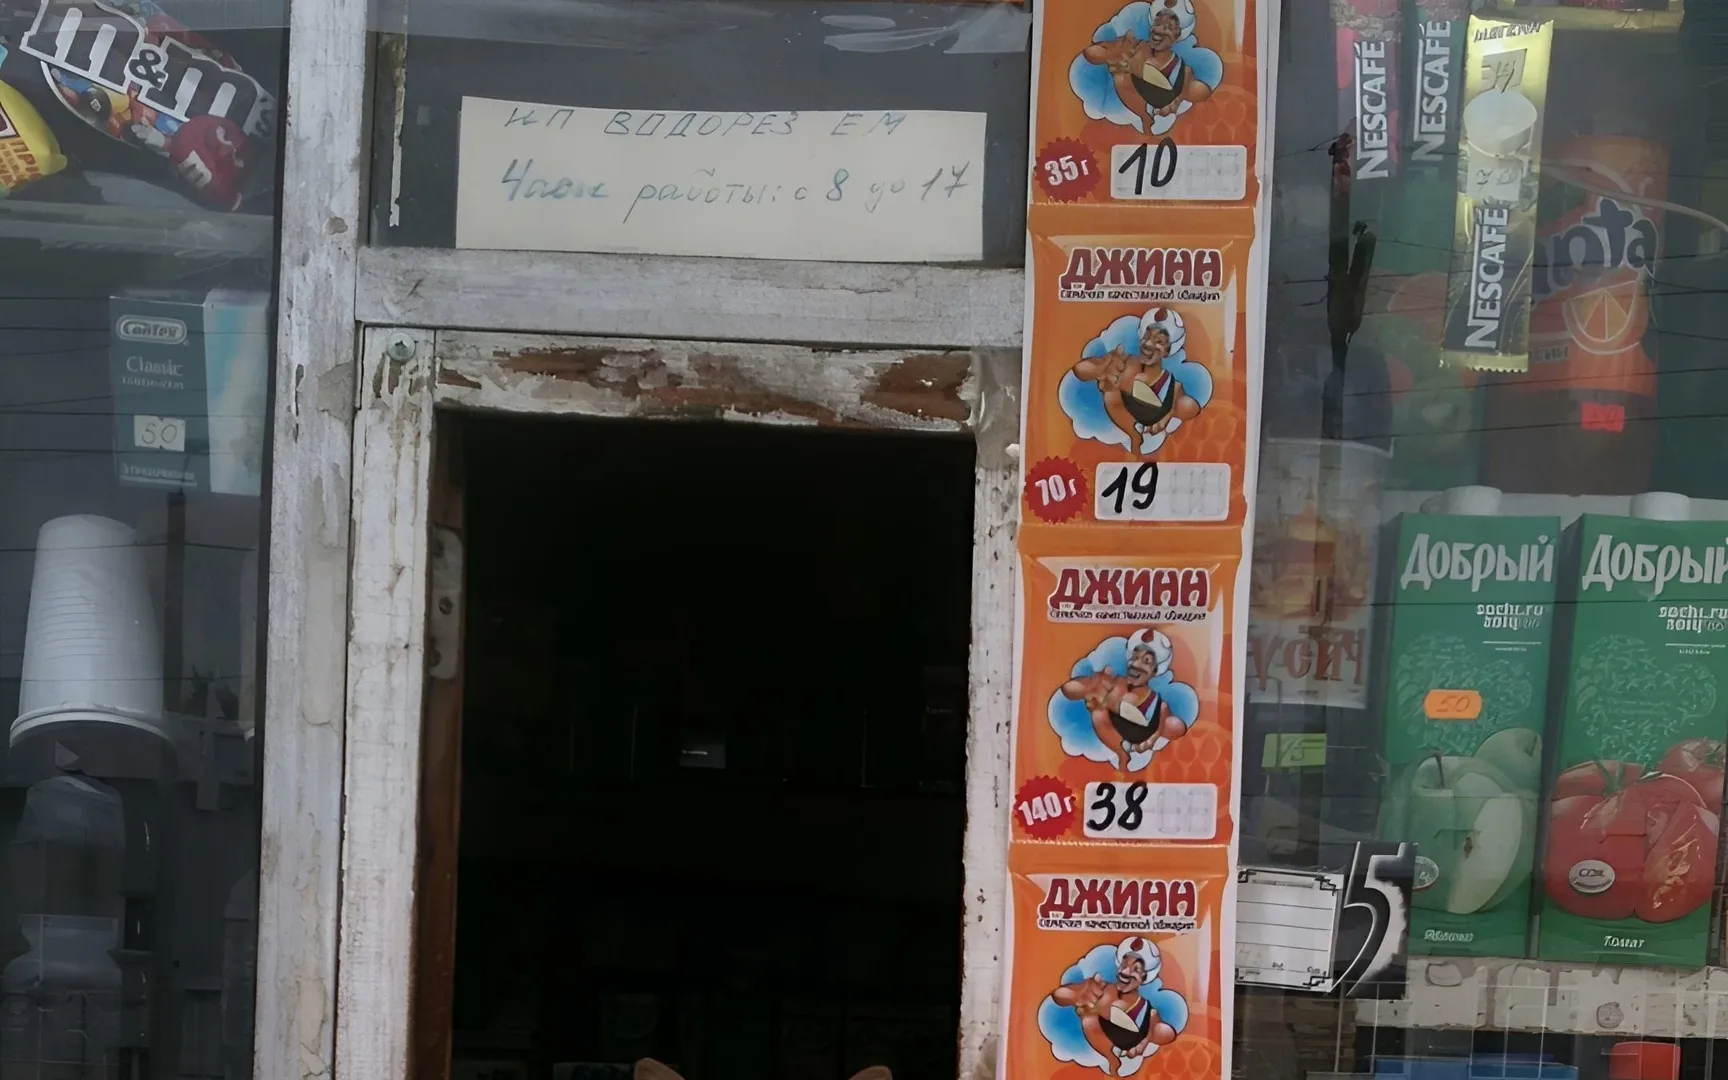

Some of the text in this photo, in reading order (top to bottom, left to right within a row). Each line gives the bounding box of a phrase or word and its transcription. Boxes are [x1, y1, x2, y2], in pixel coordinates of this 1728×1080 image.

[603, 111, 799, 140] ВОДОРЕЗ
[826, 168, 850, 201] 8
[920, 160, 971, 201] 17
[1118, 137, 1178, 195] 10
[1060, 248, 1221, 291] ДЖИНН
[1532, 197, 1658, 300] nta
[1101, 461, 1159, 514] 19
[1049, 568, 1208, 611] ДЖИНН
[1087, 780, 1149, 831] 38
[1039, 878, 1196, 919] ДЖИНН
